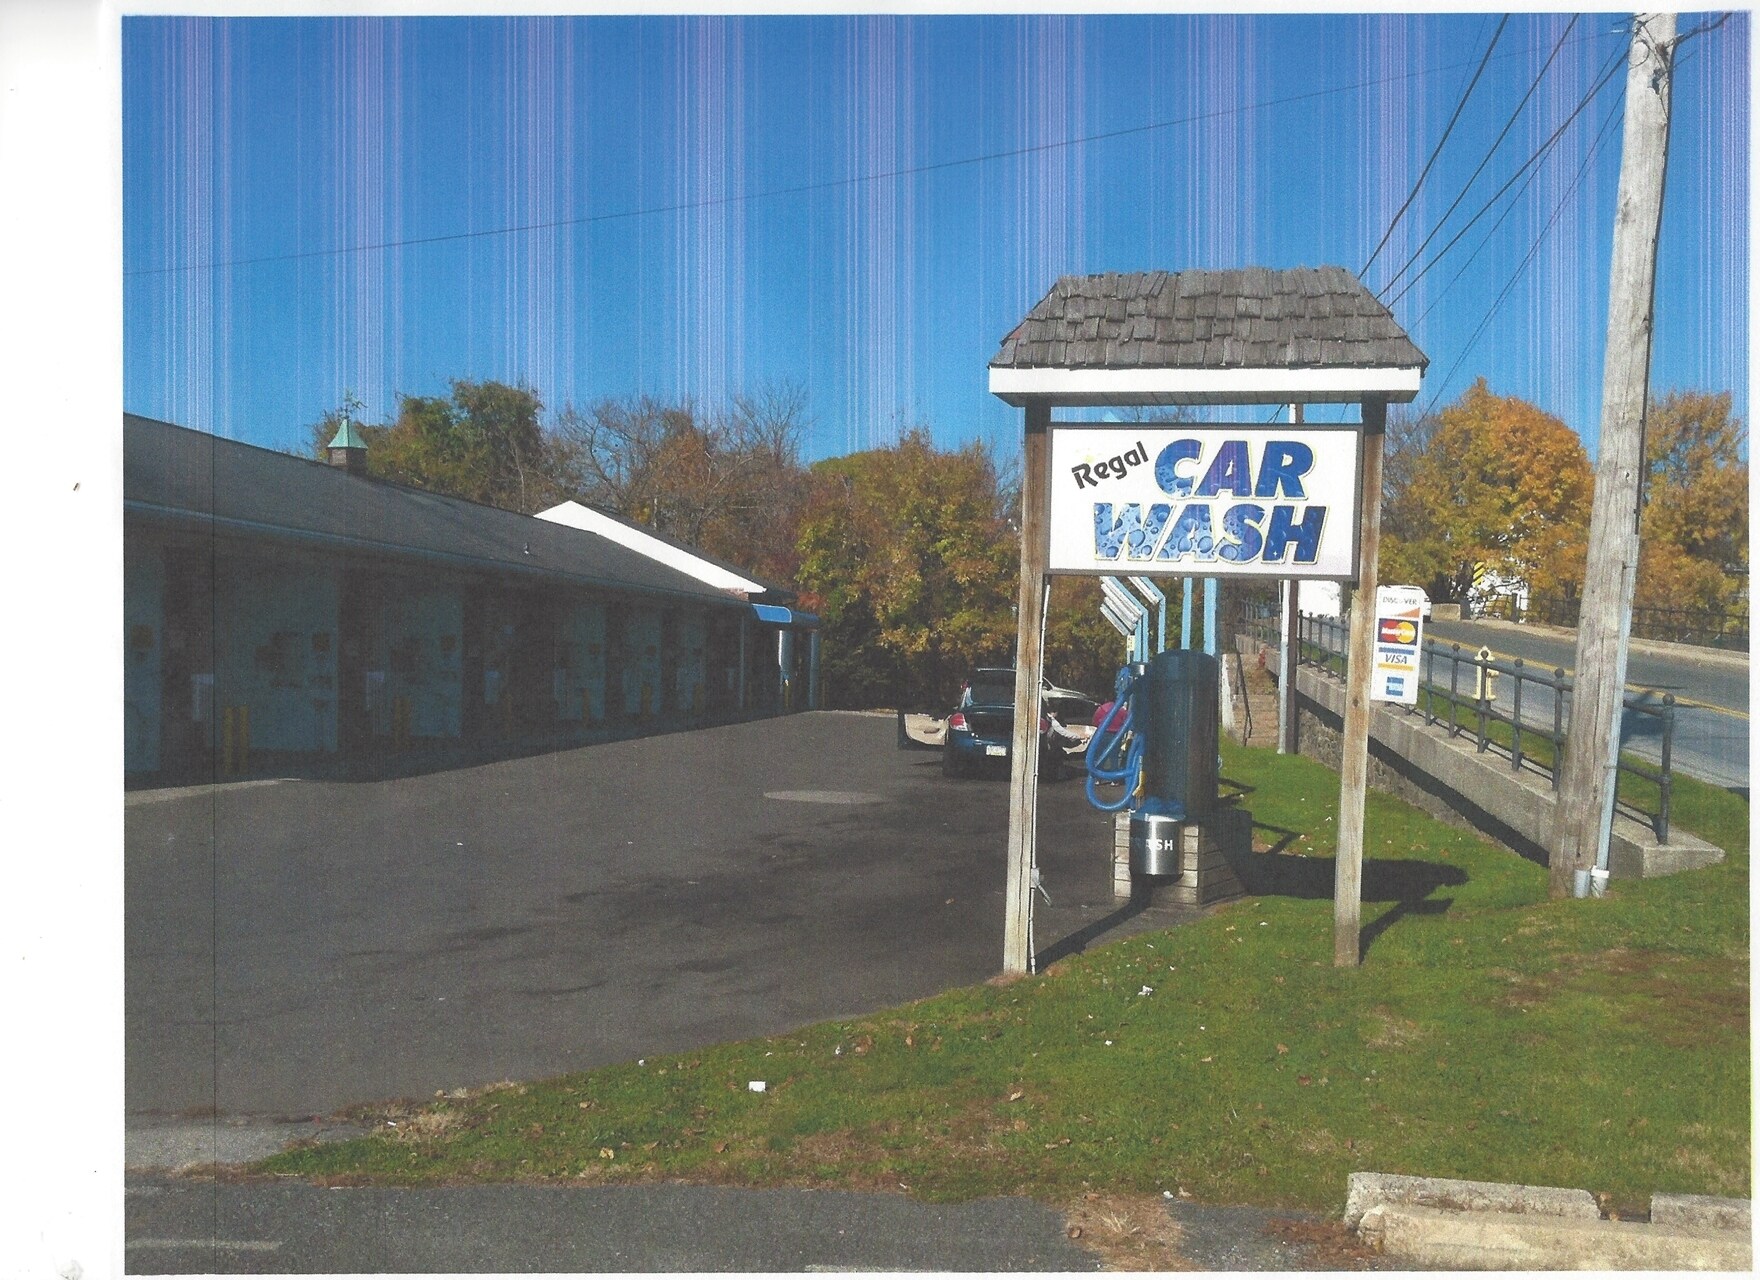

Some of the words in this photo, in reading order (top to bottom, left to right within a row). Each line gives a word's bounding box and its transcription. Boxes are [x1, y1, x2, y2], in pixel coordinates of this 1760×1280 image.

[1071, 441, 1149, 489] Regal
[1154, 438, 1315, 500] CAR
[1093, 502, 1329, 565] WASH
[1385, 654, 1408, 664] VISA
